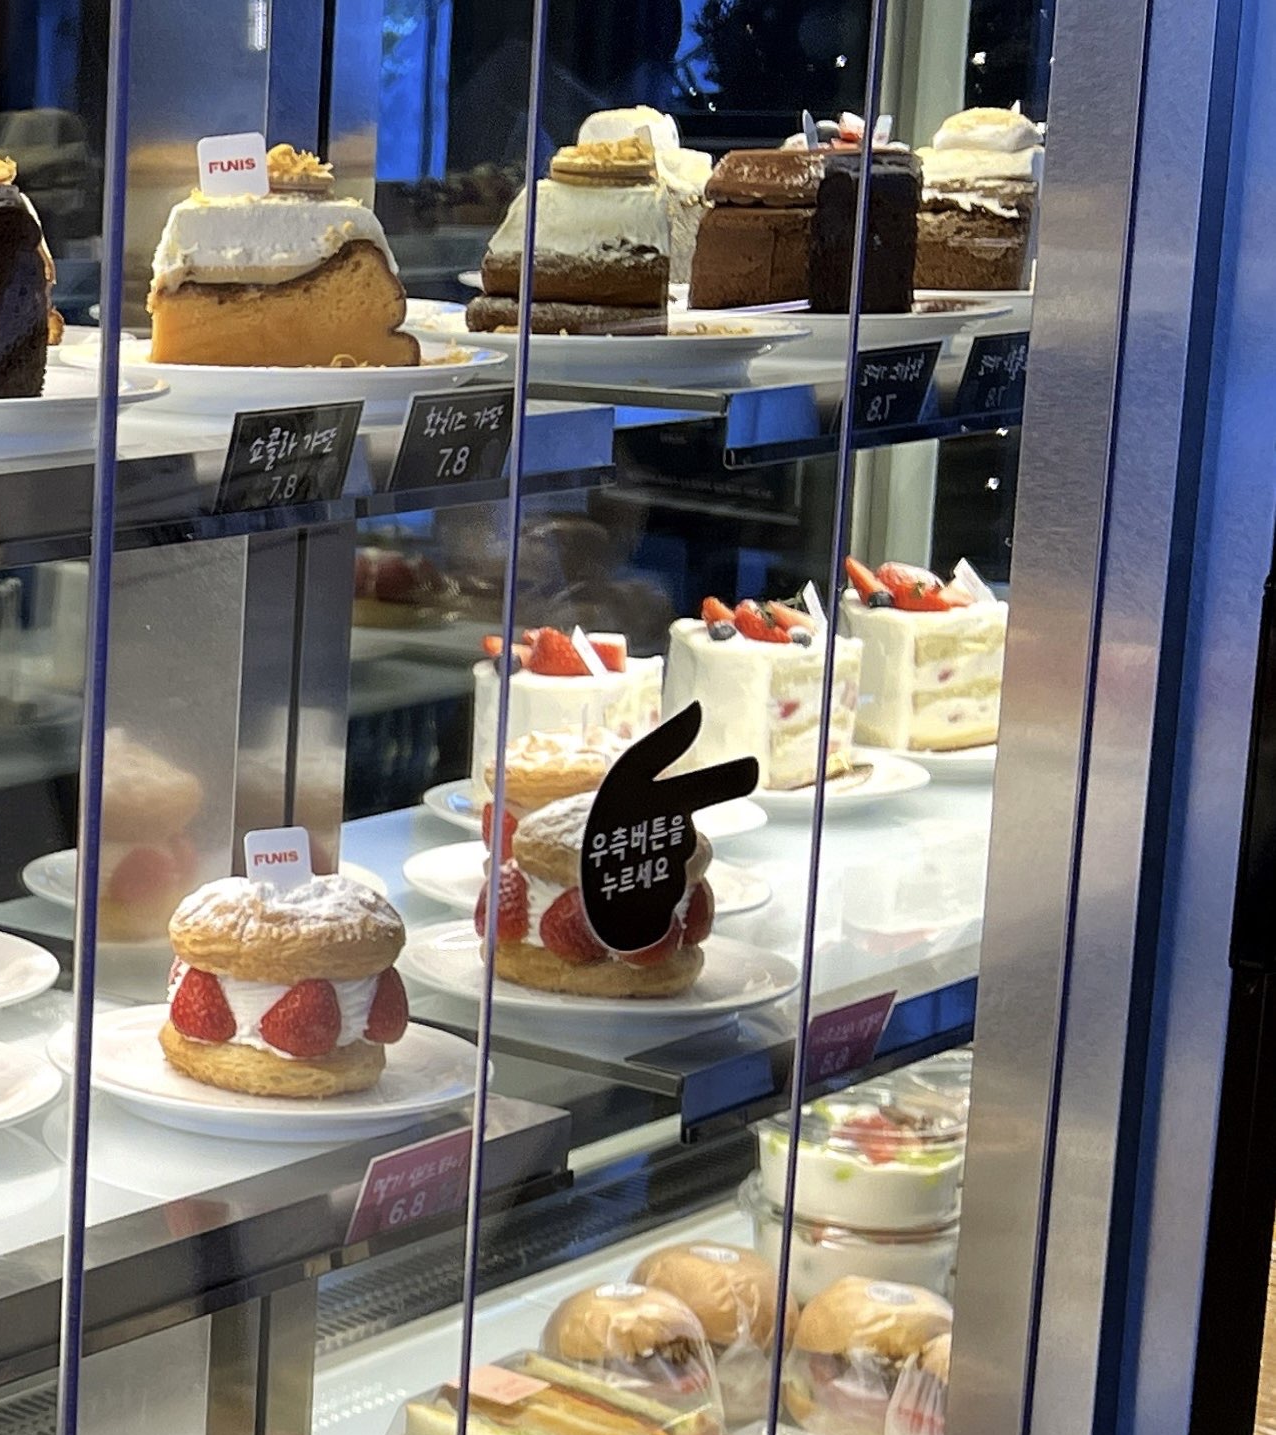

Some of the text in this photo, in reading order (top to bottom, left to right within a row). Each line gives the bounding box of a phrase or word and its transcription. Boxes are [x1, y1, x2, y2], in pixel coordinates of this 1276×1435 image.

[208, 157, 256, 175] FUNIS
[249, 427, 298, 472] 쇼콜라
[437, 446, 470, 477] 7.8
[268, 473, 298, 502] 7.8
[589, 815, 685, 868] 우측버튼을
[253, 851, 299, 867] FUNIS
[601, 857, 670, 900] 누르세요
[389, 1191, 426, 1224] 6.8
